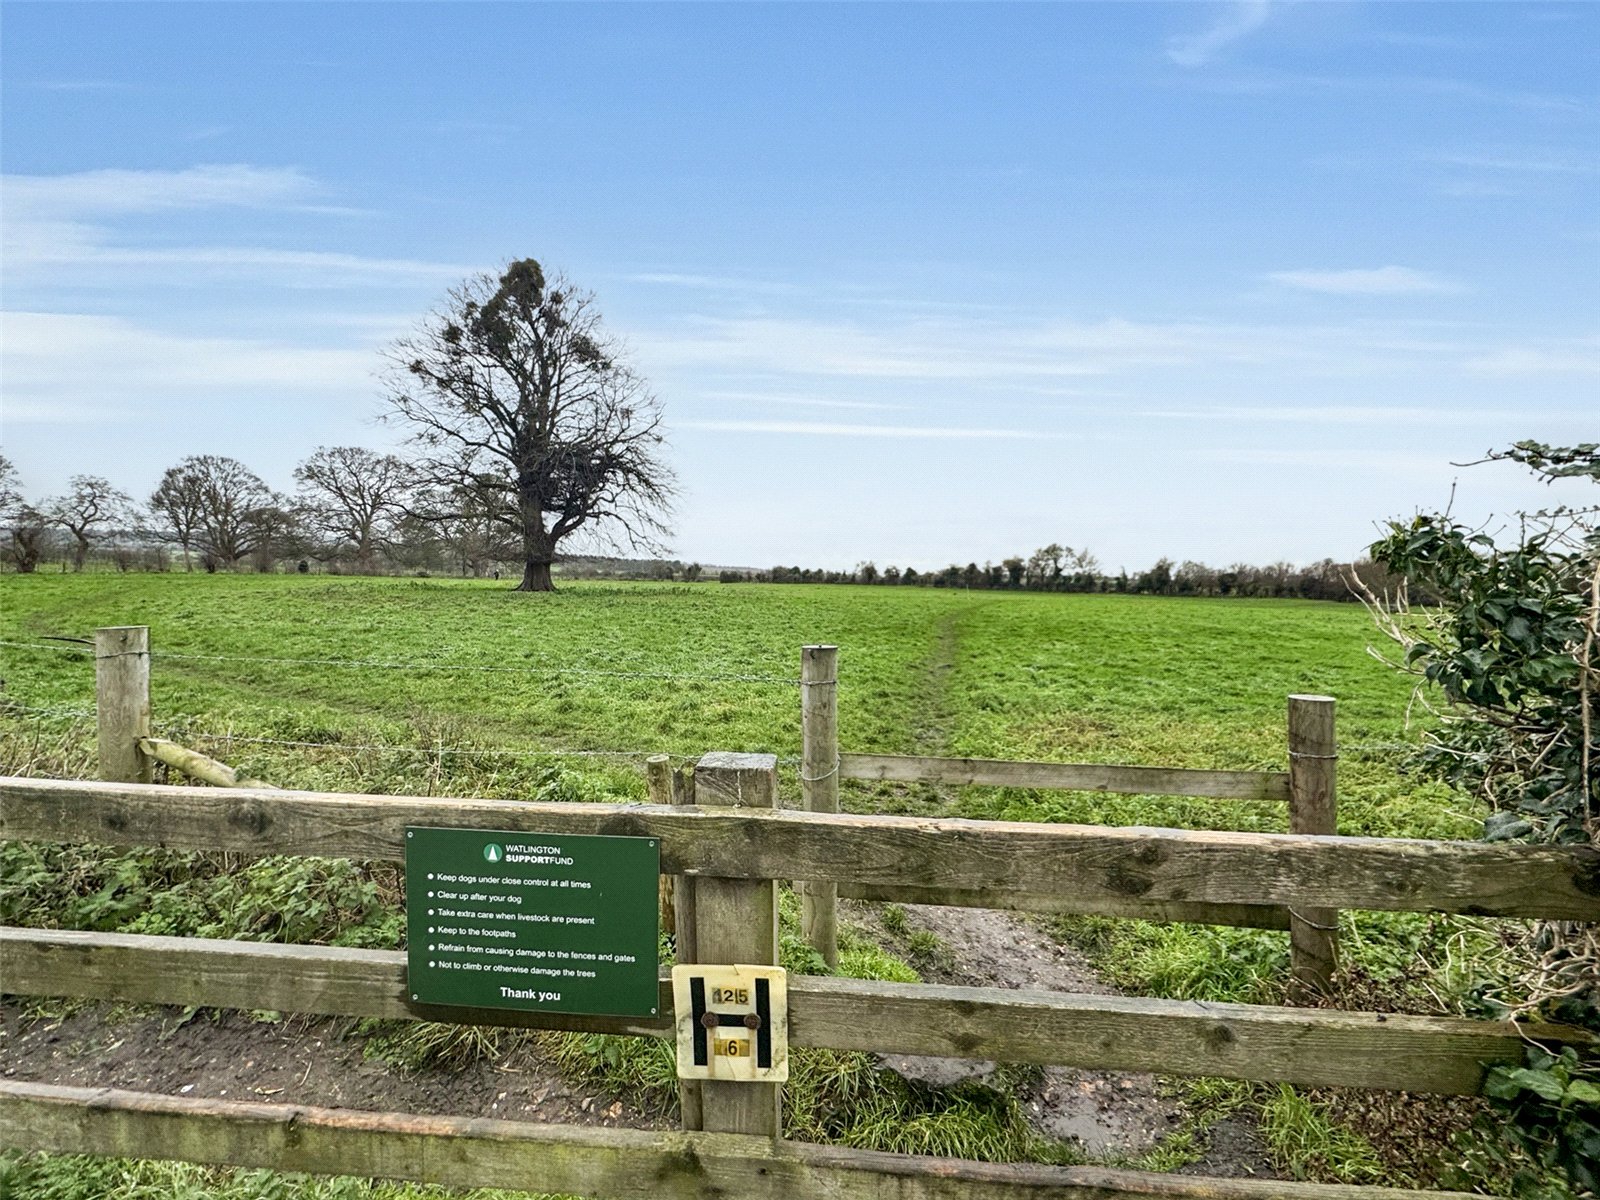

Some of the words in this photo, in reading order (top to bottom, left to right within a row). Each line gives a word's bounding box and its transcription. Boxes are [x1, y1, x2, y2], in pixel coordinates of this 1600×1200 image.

[505, 844, 561, 855] WATLINGTON
[505, 854, 574, 866] SUPPORTFUND
[436, 872, 458, 883] Keep
[457, 874, 478, 885] dogs
[477, 875, 501, 884] under
[501, 876, 522, 885] close
[522, 878, 550, 887] control
[550, 879, 559, 887] at
[559, 879, 570, 888] all
[570, 880, 592, 889] times
[436, 890, 458, 900] Clear
[458, 893, 470, 902] up
[469, 892, 488, 901] after
[488, 895, 507, 903] your
[506, 894, 523, 905] dog
[437, 907, 456, 917] Take
[456, 910, 476, 918] extra
[476, 911, 495, 919] care
[495, 912, 517, 921] when
[517, 912, 551, 923] livestock
[565, 916, 595, 925] present
[437, 925, 458, 936] Keep
[458, 927, 467, 935] to
[467, 927, 481, 936] the
[481, 928, 517, 939] footpaths
[437, 942, 466, 952] Refrain
[466, 944, 484, 954] from
[484, 947, 515, 958] causing
[515, 948, 547, 959] damage
[547, 950, 556, 958] to
[556, 950, 570, 959] the
[570, 950, 597, 961] fences
[597, 953, 613, 962] and
[613, 954, 636, 964] gates
[438, 960, 453, 969] Not
[453, 961, 462, 970] to
[462, 962, 483, 971] climb
[483, 964, 492, 972] or
[492, 964, 530, 974] otherwise
[529, 966, 562, 978] damage
[562, 968, 576, 977] the
[576, 969, 597, 978] trees
[499, 986, 537, 1000] Thank
[538, 991, 561, 1003] you
[727, 1040, 738, 1056] 6
